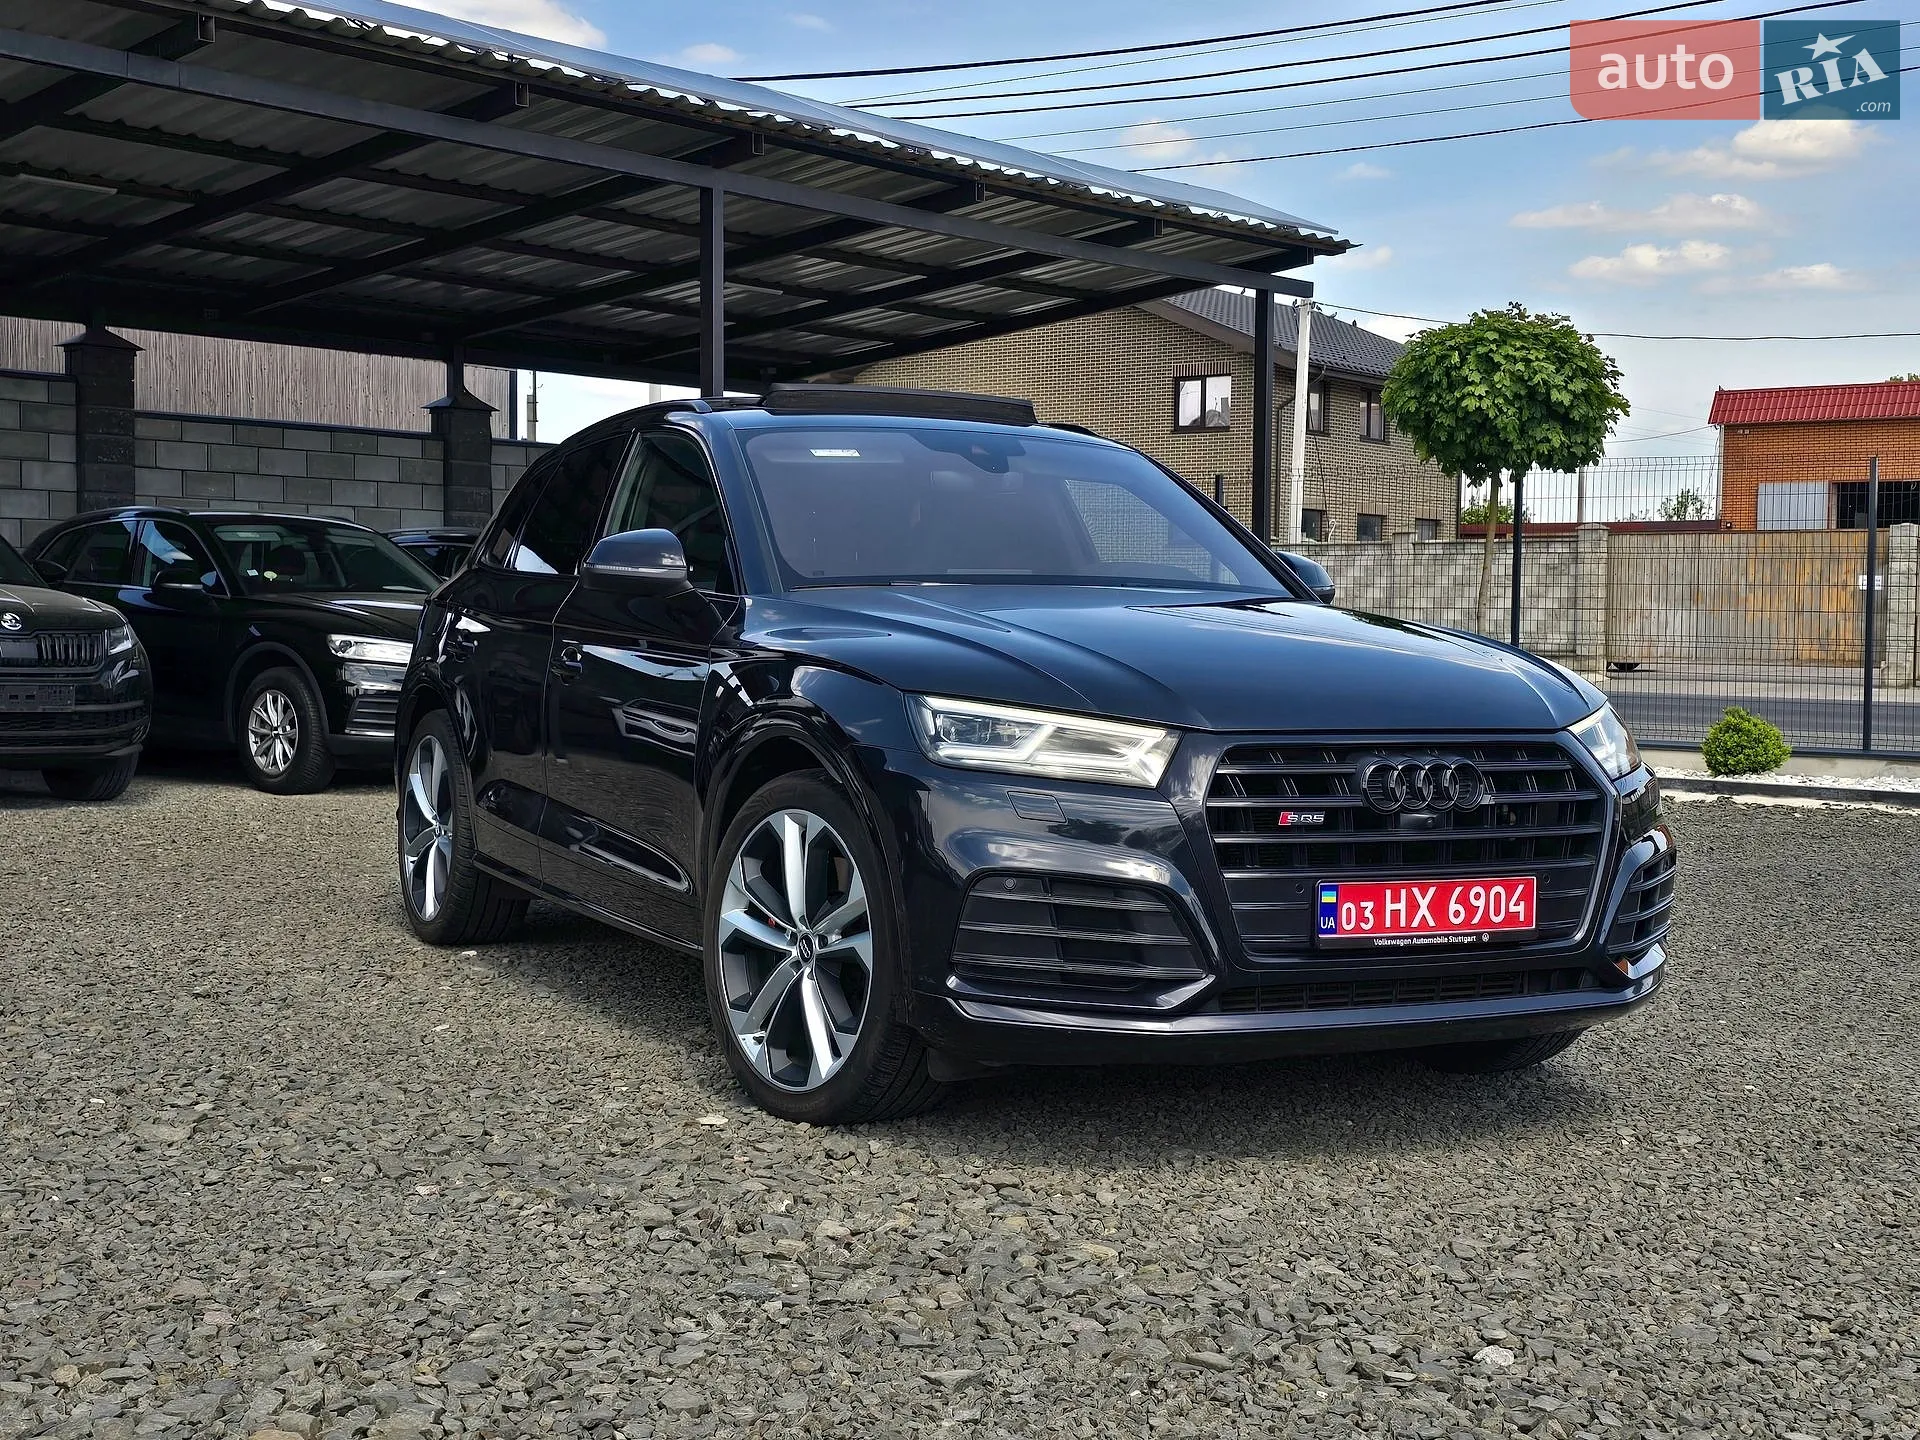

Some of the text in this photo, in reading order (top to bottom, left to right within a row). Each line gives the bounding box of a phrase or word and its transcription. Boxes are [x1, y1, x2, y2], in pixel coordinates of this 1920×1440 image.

[1341, 884, 1525, 931] 03 HX 6904
[1320, 916, 1336, 929] UA
[1374, 935, 1477, 947] Volkswagen Automobile Stuttgart
